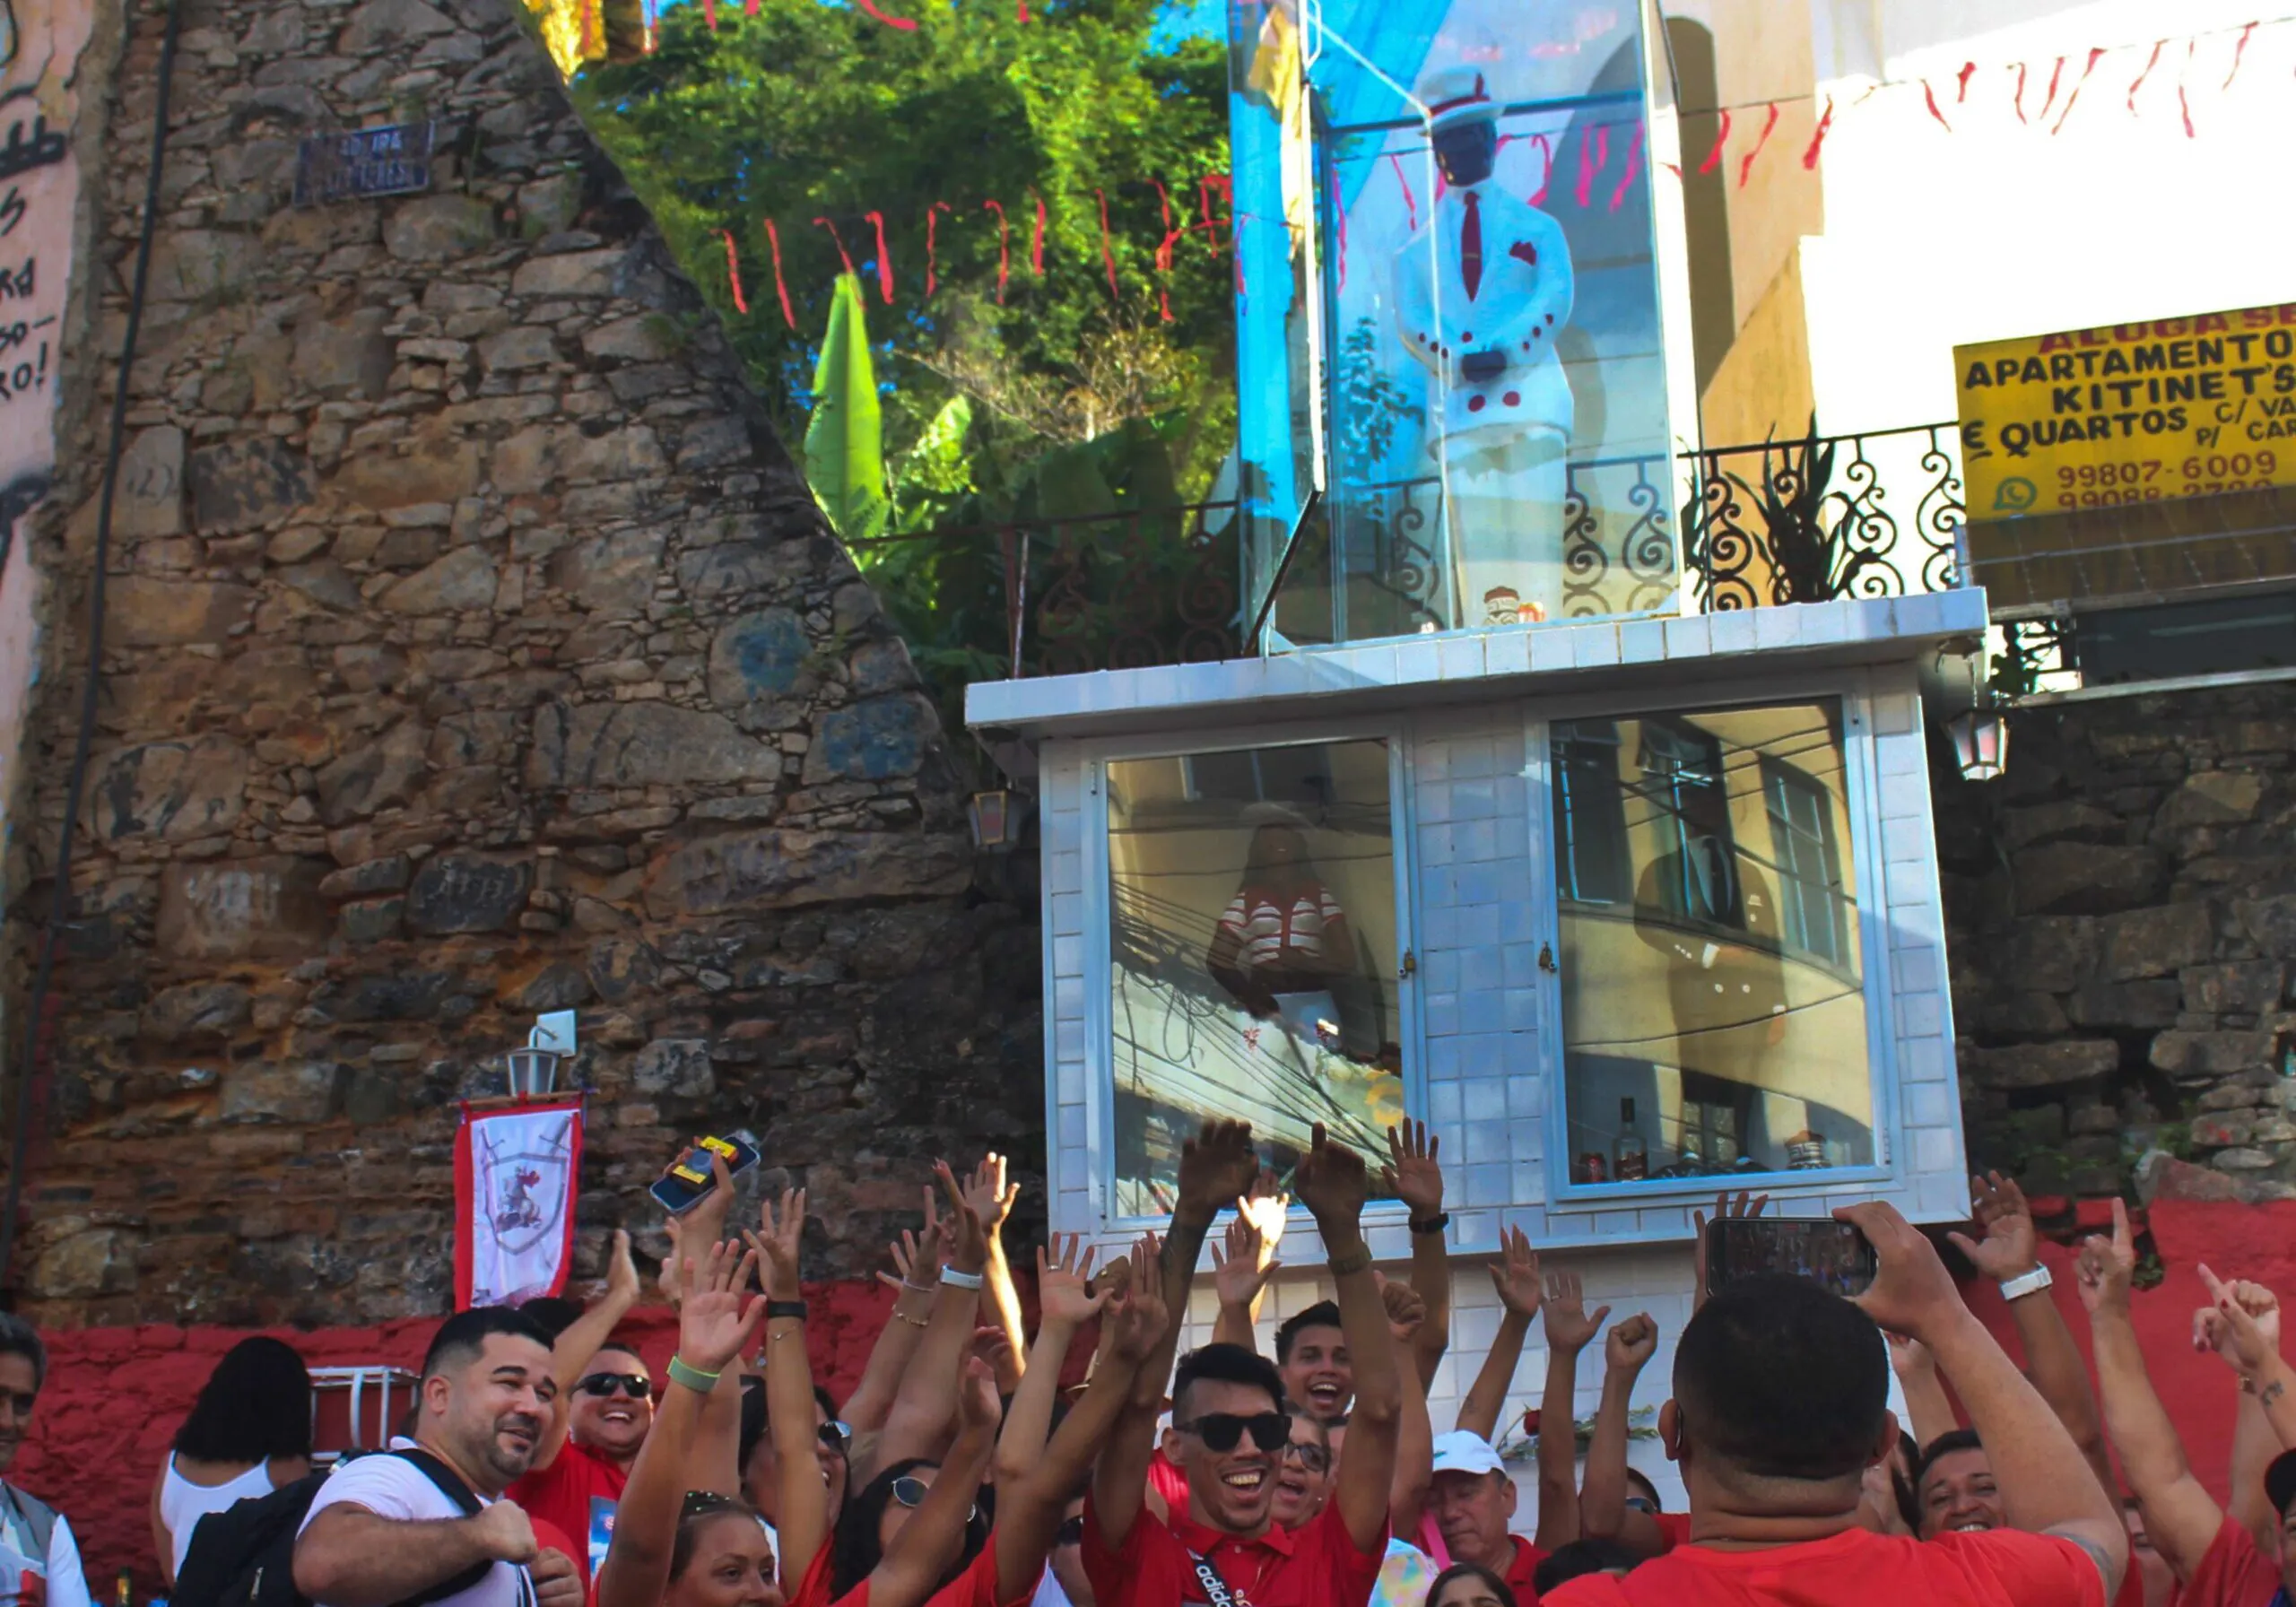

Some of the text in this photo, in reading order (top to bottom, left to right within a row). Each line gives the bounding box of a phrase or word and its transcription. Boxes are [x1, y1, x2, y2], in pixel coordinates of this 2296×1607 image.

[1965, 329, 2293, 389] APARTAMENTO
[2215, 397, 2248, 425] C/
[1962, 406, 2187, 458] E QUARTOS
[2196, 425, 2221, 449] P/
[2057, 450, 2277, 490] 99807-6009
